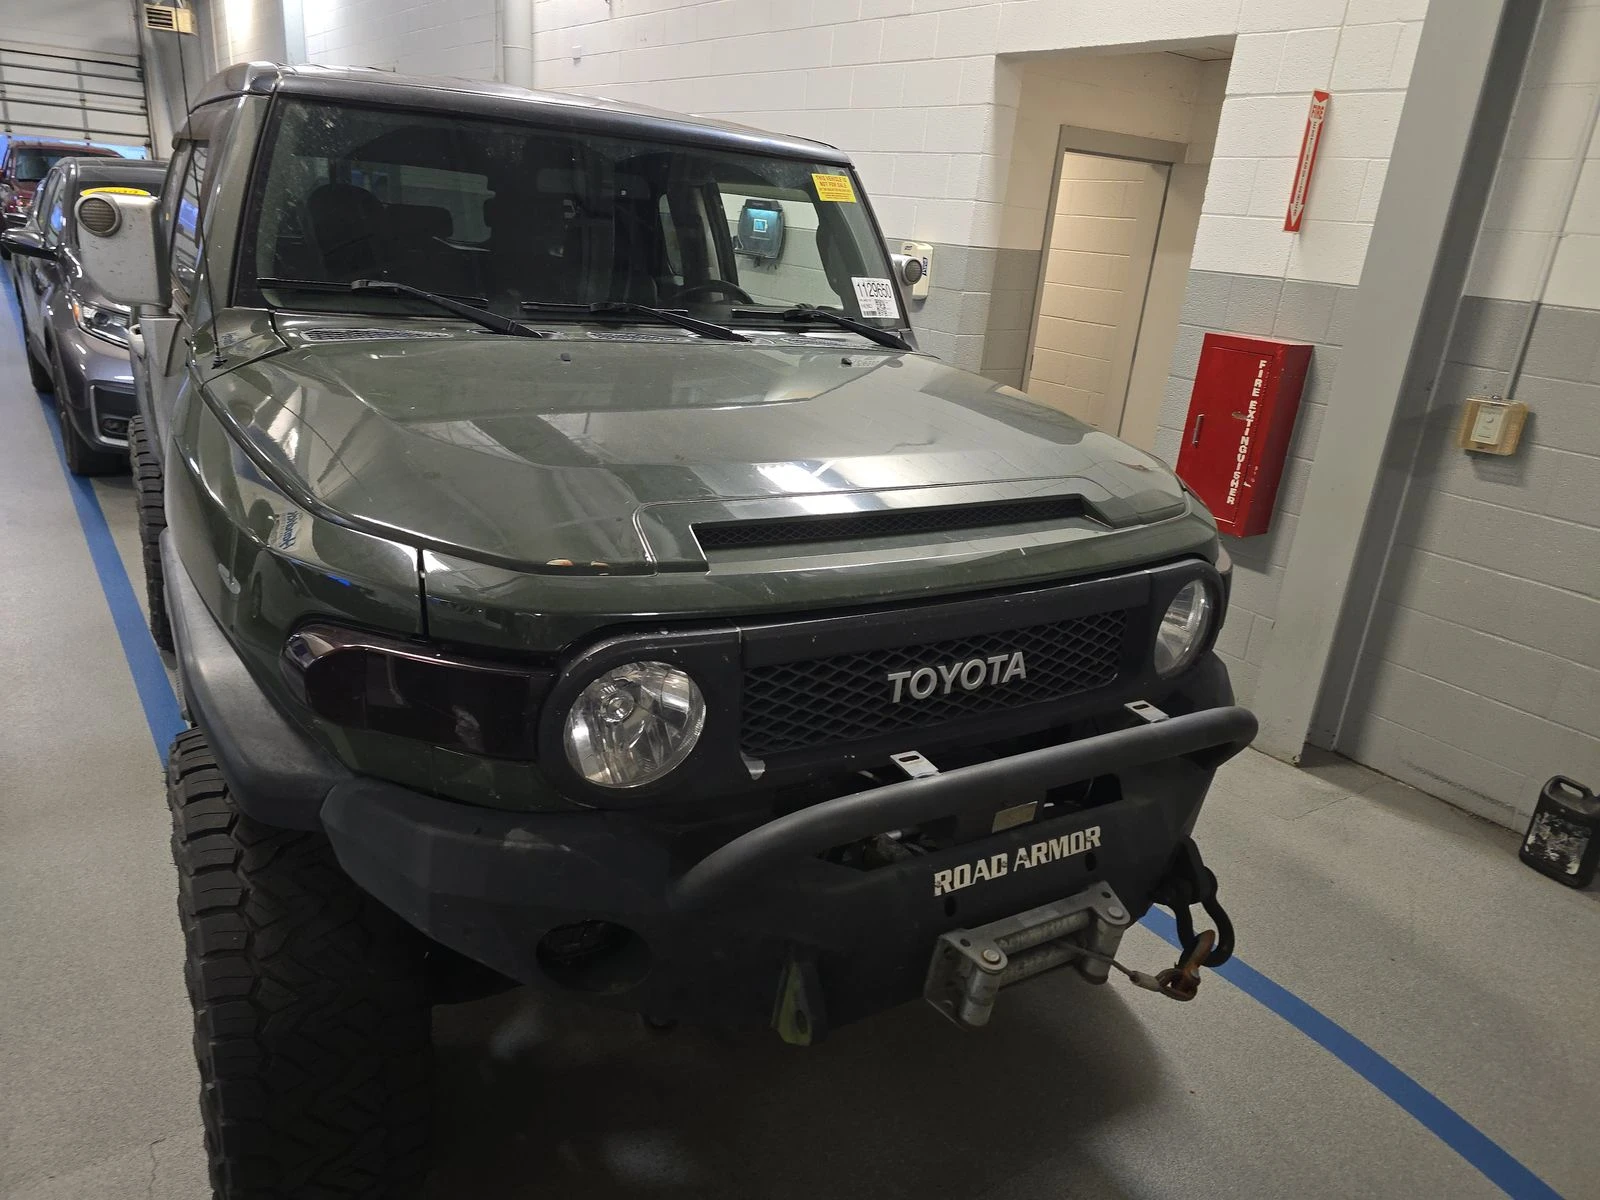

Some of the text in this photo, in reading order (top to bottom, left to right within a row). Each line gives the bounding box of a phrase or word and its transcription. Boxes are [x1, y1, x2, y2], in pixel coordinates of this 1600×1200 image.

[857, 282, 892, 299] 1129650
[1226, 359, 1268, 505] FIRE EXTINGUISHER
[887, 651, 1027, 703] TOYOTA
[934, 825, 1101, 897] ROAD ARMOR
